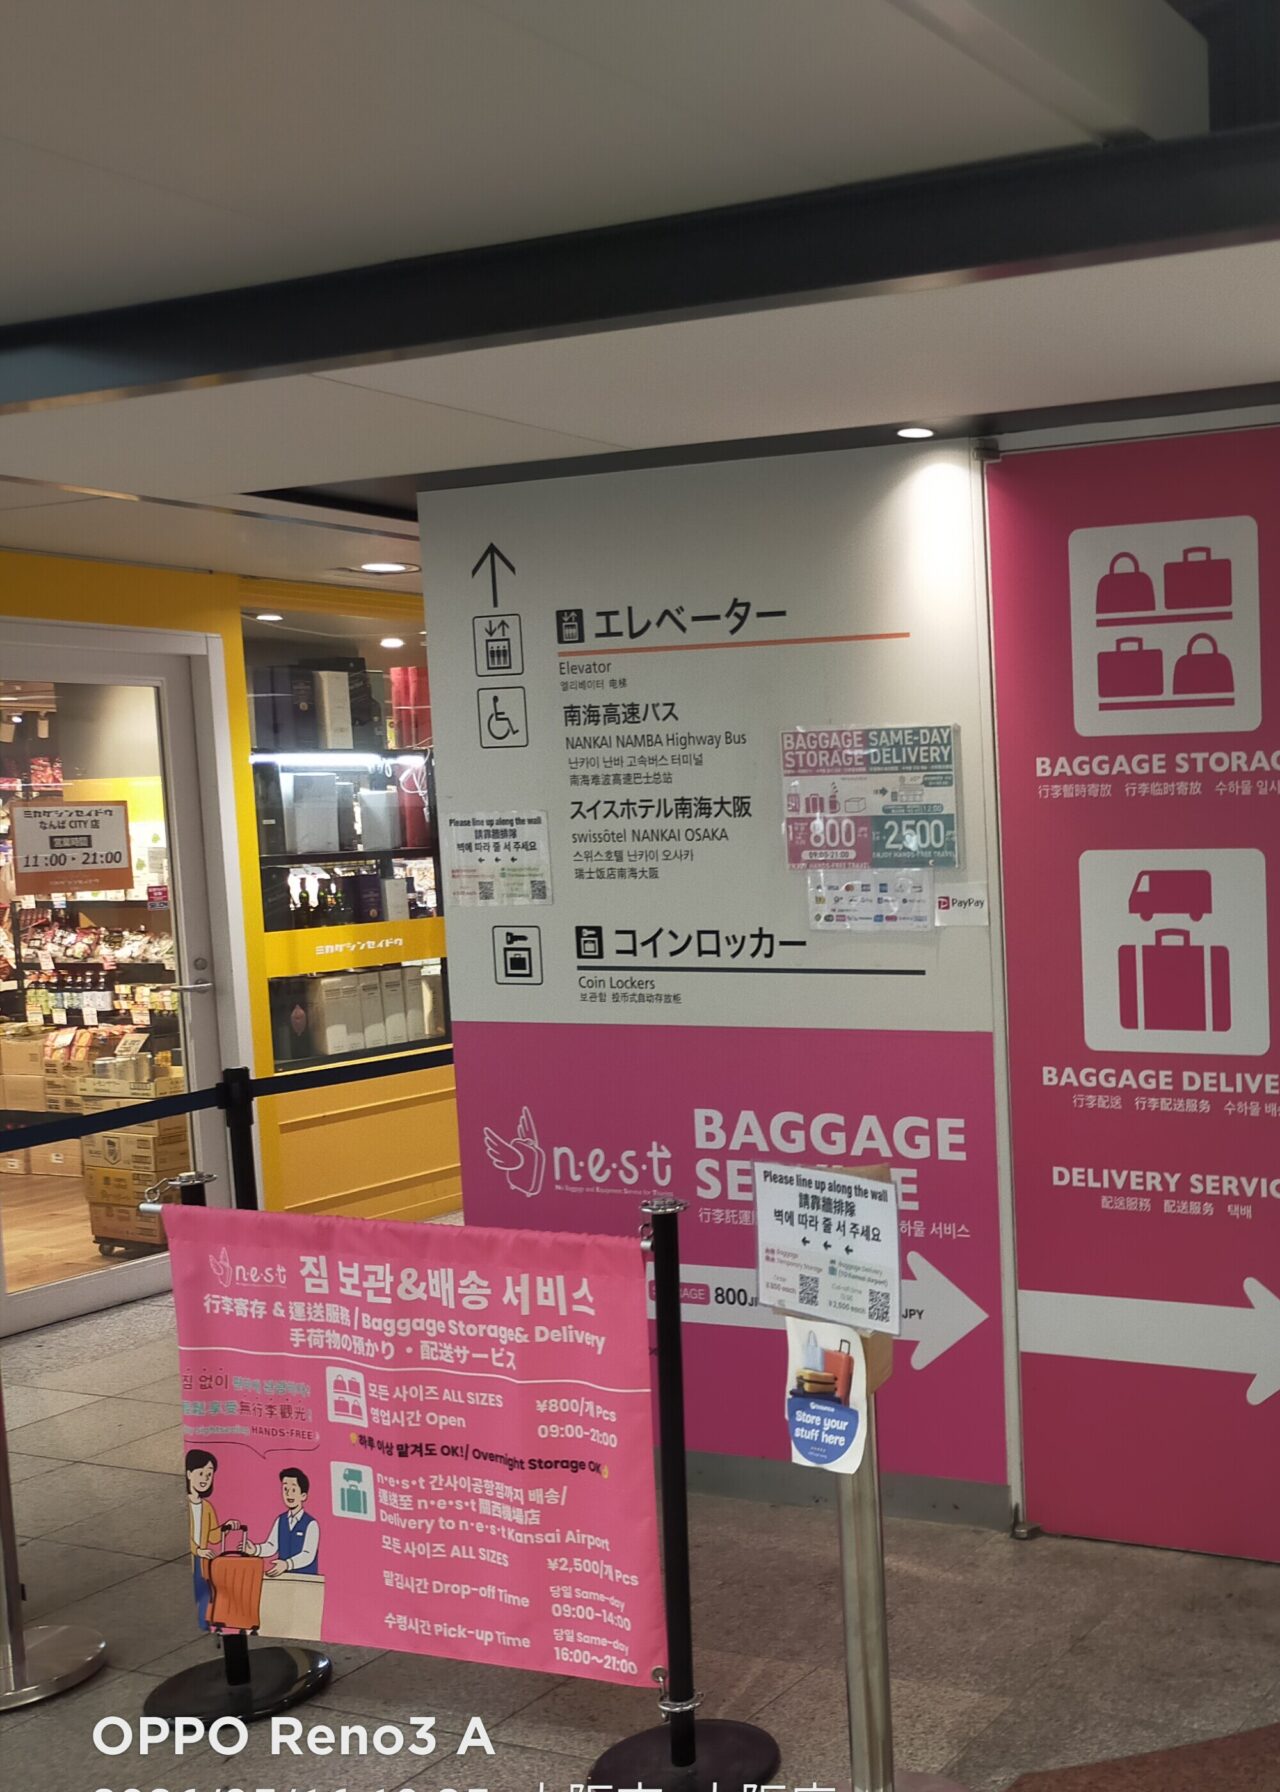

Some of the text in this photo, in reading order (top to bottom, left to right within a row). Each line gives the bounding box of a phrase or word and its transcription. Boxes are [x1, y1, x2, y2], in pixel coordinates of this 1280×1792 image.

[594, 597, 787, 639] エレベーター
[559, 660, 612, 676] Elevator
[559, 679, 605, 691] 엘리베이터
[563, 702, 680, 727] 南海高速バス
[565, 731, 747, 751] NANKAI NAMBA Highway Bus
[782, 727, 950, 751] BAGGAGE SAME-DAY
[568, 755, 624, 769] 난카이 난바
[785, 747, 951, 768] STORAGE DELIVERY
[1036, 753, 1167, 777] BAGGAGE
[1215, 779, 1253, 795] 수하물
[570, 796, 752, 820] スイスホテル南海大阪
[69, 820, 88, 829] CITY
[572, 828, 729, 844] swissôtel NANKAI OSAKA
[810, 819, 855, 847] 800
[82, 851, 122, 865] 21:00
[573, 849, 694, 862] 스위스호텔 난카이 오사카
[951, 895, 985, 909] PayPay
[614, 927, 807, 959] コインロッカー
[578, 976, 655, 990] Coin Lockers
[1042, 1066, 1173, 1090] BAGGAGE
[1072, 1094, 1122, 1110] 行李配送
[1134, 1096, 1211, 1114] 行李配送服务
[1223, 1100, 1261, 1117] 수하물
[693, 1107, 967, 1161] BAGGAGE
[763, 1170, 889, 1202] Please line up along the wall
[1052, 1166, 1181, 1194] DELIVERY
[1227, 1204, 1252, 1219] 택배
[774, 1208, 882, 1243] 벽에 따라 줄 서 주세요
[930, 1221, 971, 1240] 서비스
[299, 1255, 596, 1316] 짐 보관&배송 서비스
[204, 1293, 267, 1320] 行李寄存
[272, 1302, 286, 1318] &
[534, 1325, 606, 1355] Delivery
[182, 1375, 193, 1390] 짐
[199, 1375, 228, 1390] 없이
[368, 1383, 503, 1408] 모든 사이즈 ALL SIZES
[370, 1407, 466, 1430] 영업시간 Open
[795, 1410, 848, 1432] Store your
[537, 1424, 618, 1448] 09:00-21:00
[794, 1427, 846, 1447] stuff here
[358, 1434, 375, 1450] 하루
[377, 1439, 394, 1456] 이상
[472, 1448, 525, 1471] Overnight
[528, 1457, 586, 1473] Storage
[379, 1509, 435, 1534] Delivery
[438, 1516, 456, 1530] to
[565, 1529, 611, 1551] Airport
[381, 1535, 509, 1568] 모든 사이즈 ALL SIZES
[432, 1580, 496, 1600] Drop-off
[496, 1588, 531, 1608] Time
[549, 1585, 625, 1612] 당일 Same-day
[551, 1603, 632, 1632] 09:00-14:00
[434, 1623, 494, 1646] Pick-up
[495, 1630, 531, 1649] Time
[553, 1628, 629, 1656] 당일 Same-day
